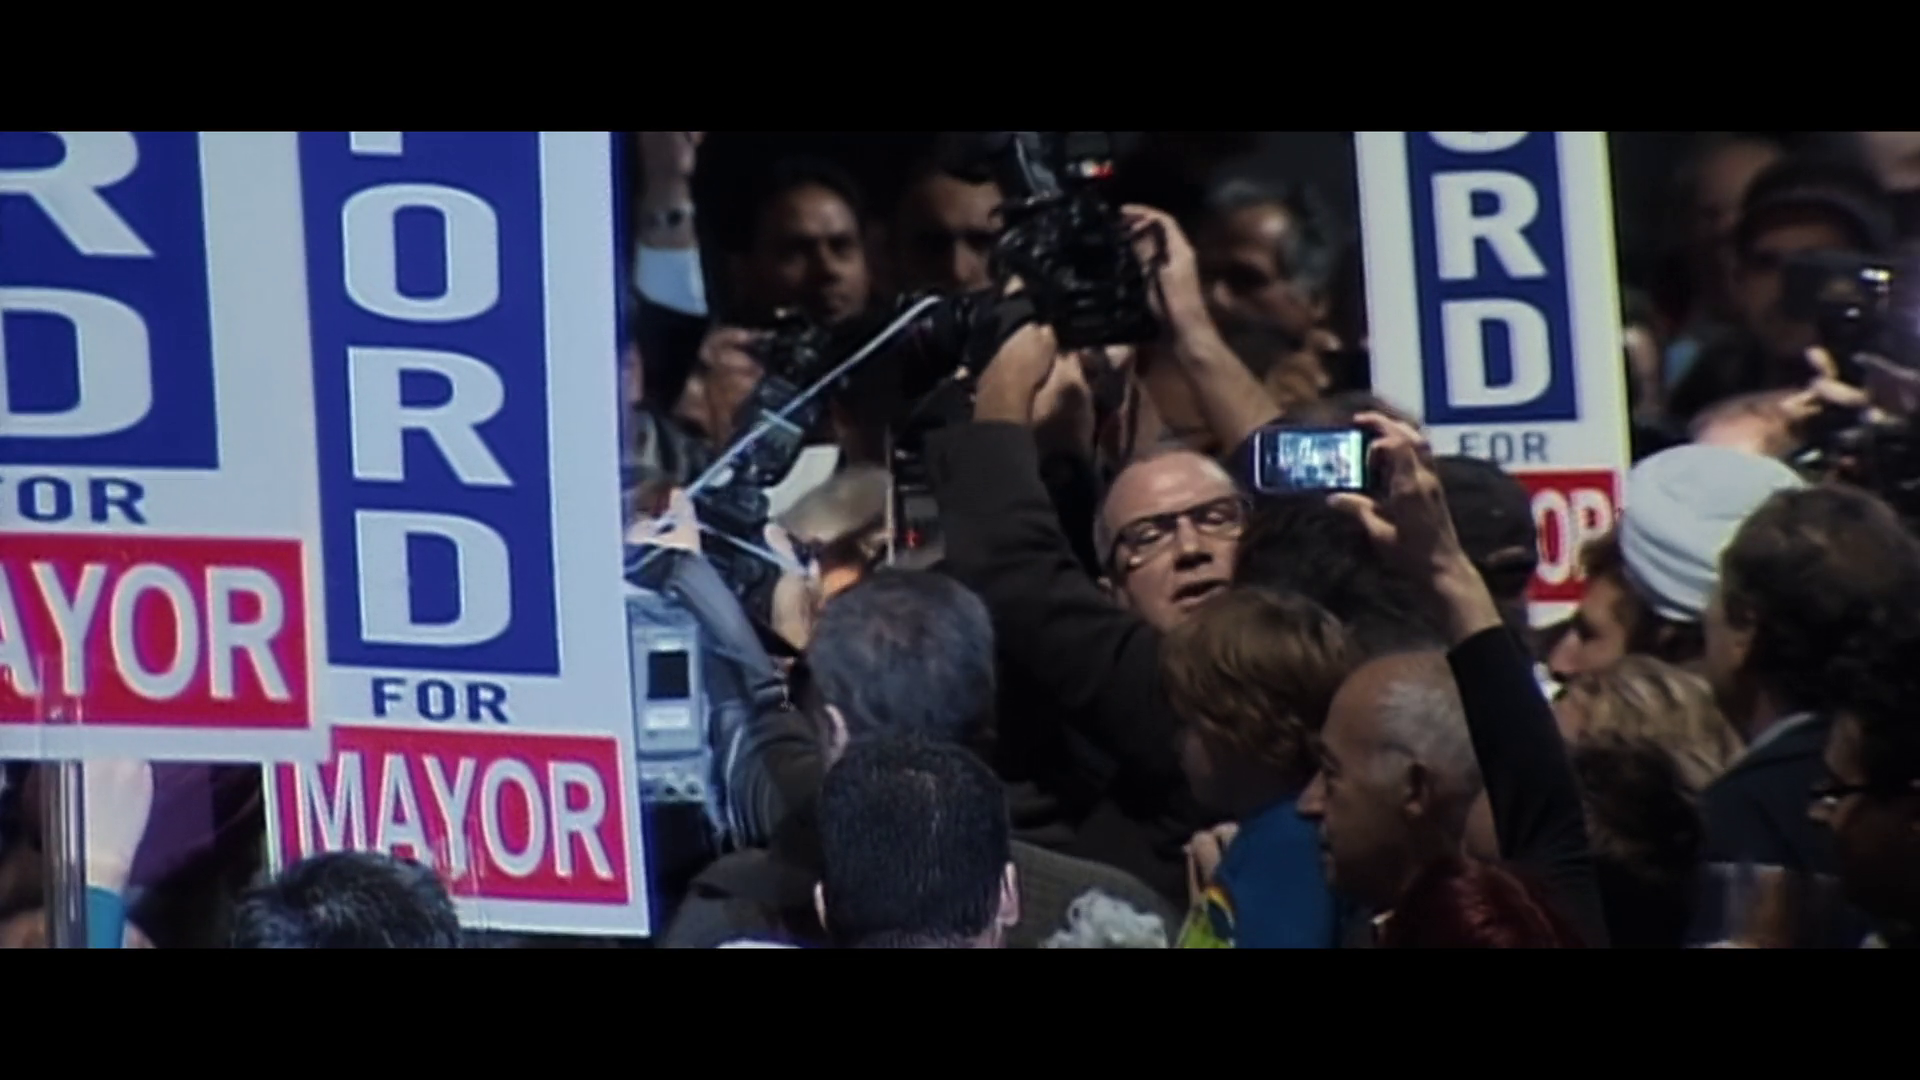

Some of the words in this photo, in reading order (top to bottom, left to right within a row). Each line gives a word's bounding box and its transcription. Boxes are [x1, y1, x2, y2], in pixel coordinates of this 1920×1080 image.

[1427, 132, 1551, 408] RD
[341, 132, 515, 648] ORD
[0, 476, 147, 524] OR
[371, 677, 508, 724] FOR
[294, 750, 614, 881] MAYOR
